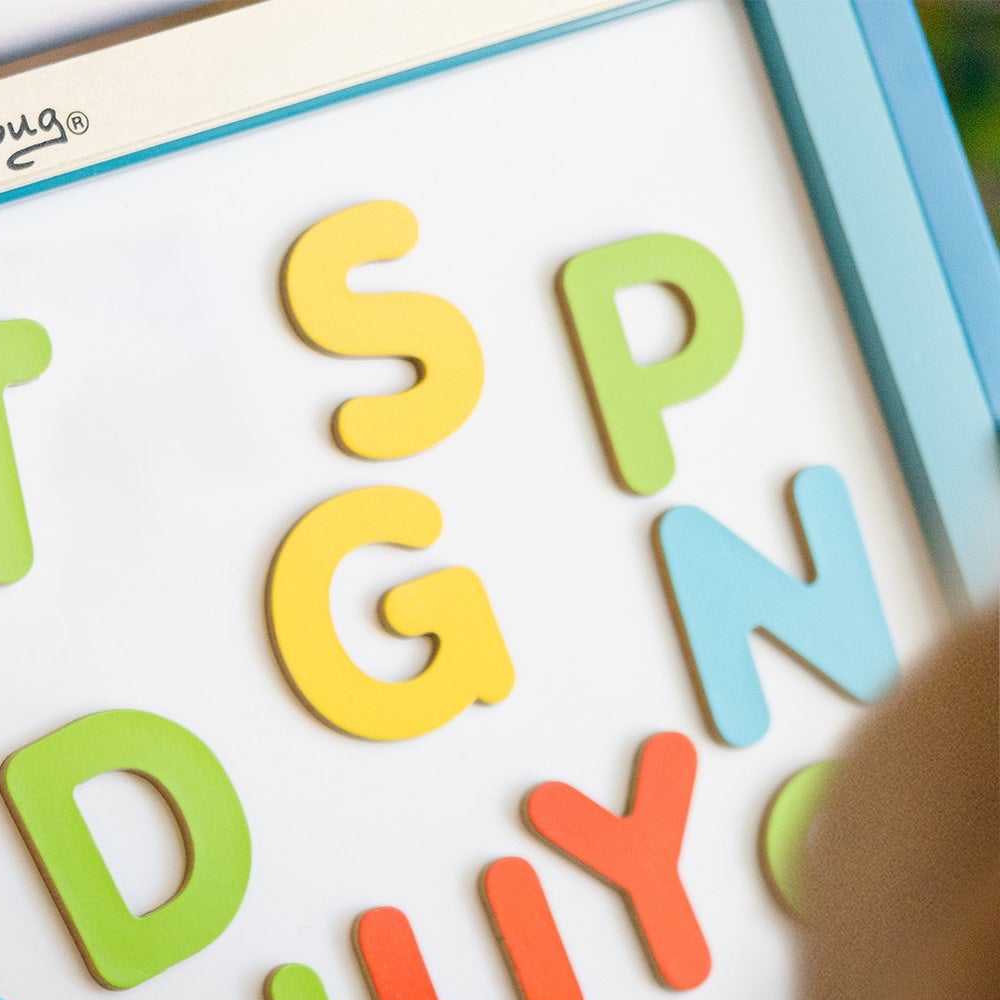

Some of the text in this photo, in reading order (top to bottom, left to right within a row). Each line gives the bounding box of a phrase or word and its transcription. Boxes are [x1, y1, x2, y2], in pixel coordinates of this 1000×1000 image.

[280, 198, 486, 462] S
[555, 232, 745, 496] P
[266, 484, 517, 741] G
[653, 464, 902, 748] N
[520, 730, 713, 992] Y
